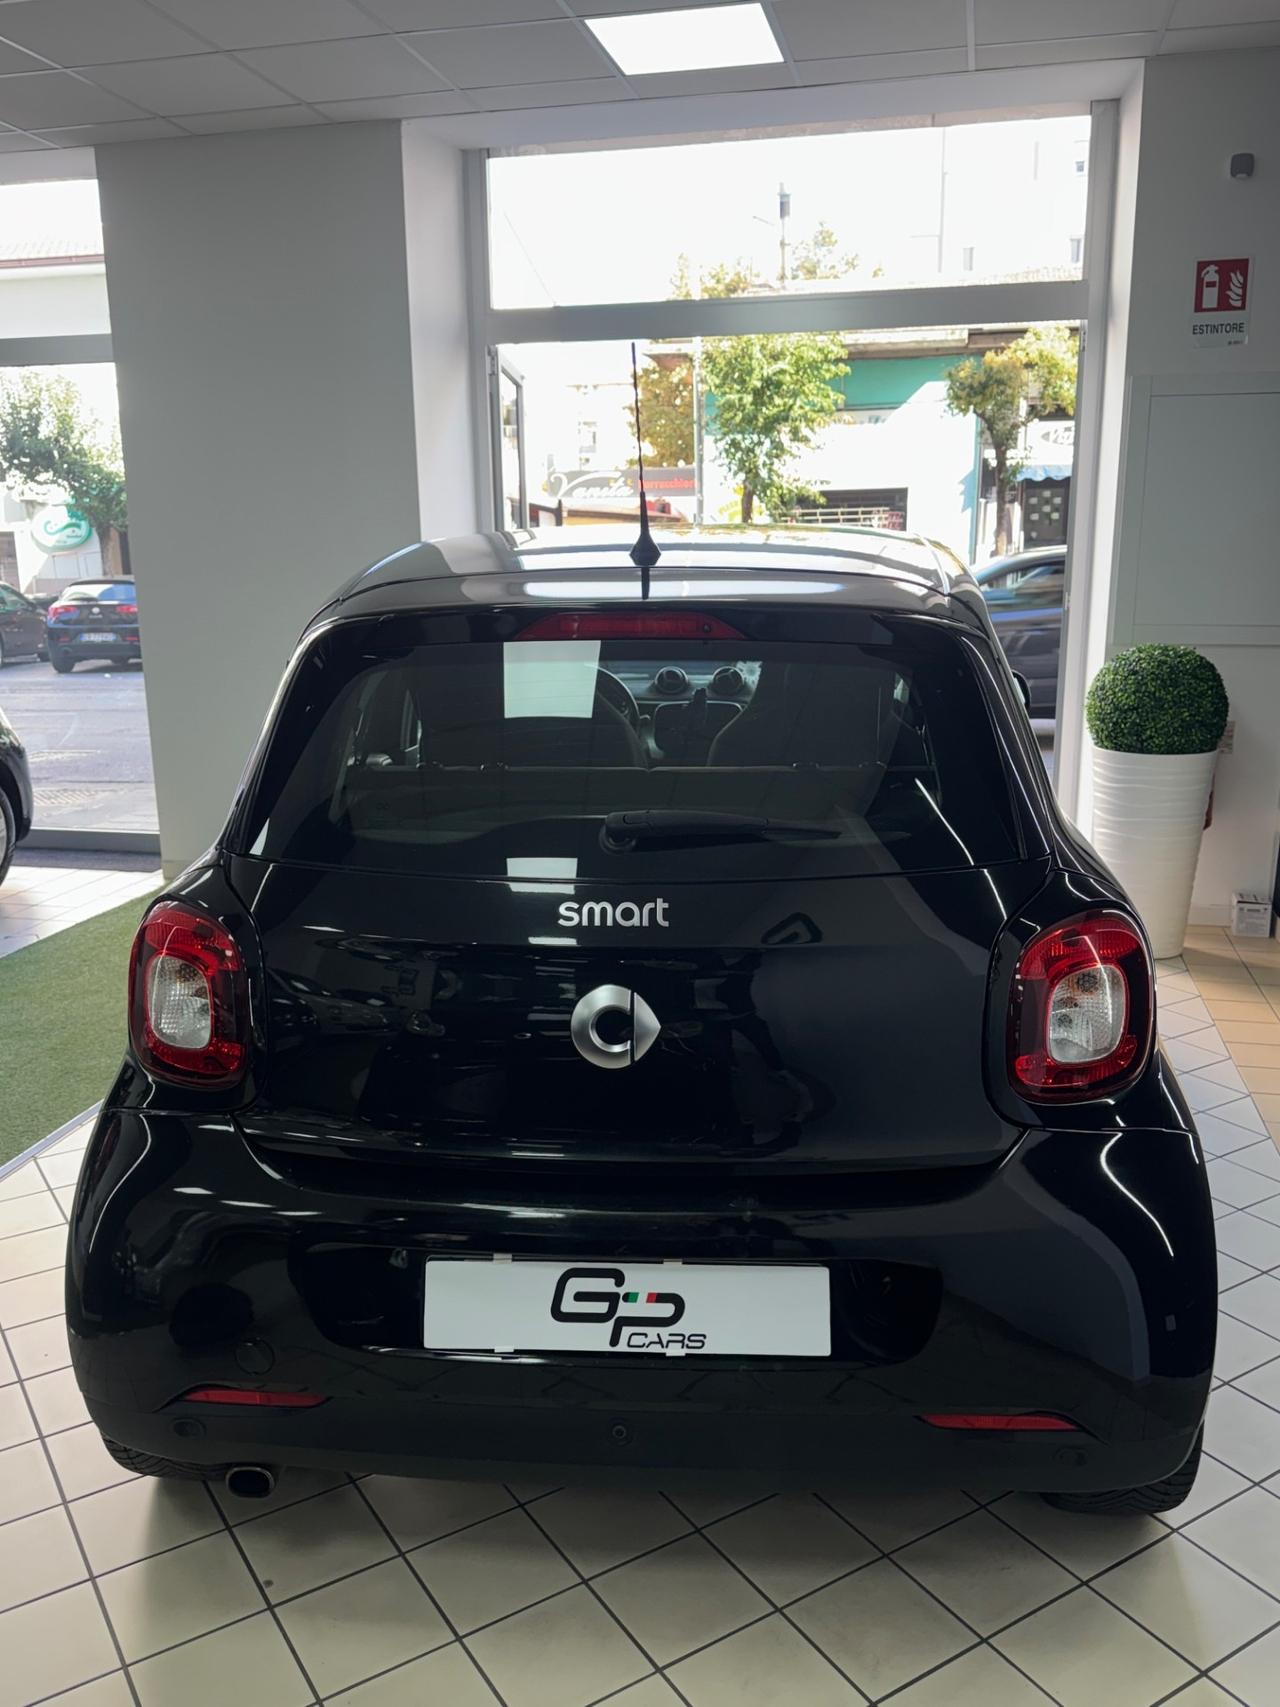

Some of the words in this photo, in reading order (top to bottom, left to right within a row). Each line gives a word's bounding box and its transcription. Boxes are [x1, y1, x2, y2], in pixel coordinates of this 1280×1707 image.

[1192, 322, 1245, 335] ESTINTORE
[558, 898, 669, 927] smart
[550, 1267, 686, 1347] GP
[626, 1332, 707, 1349] CARS
